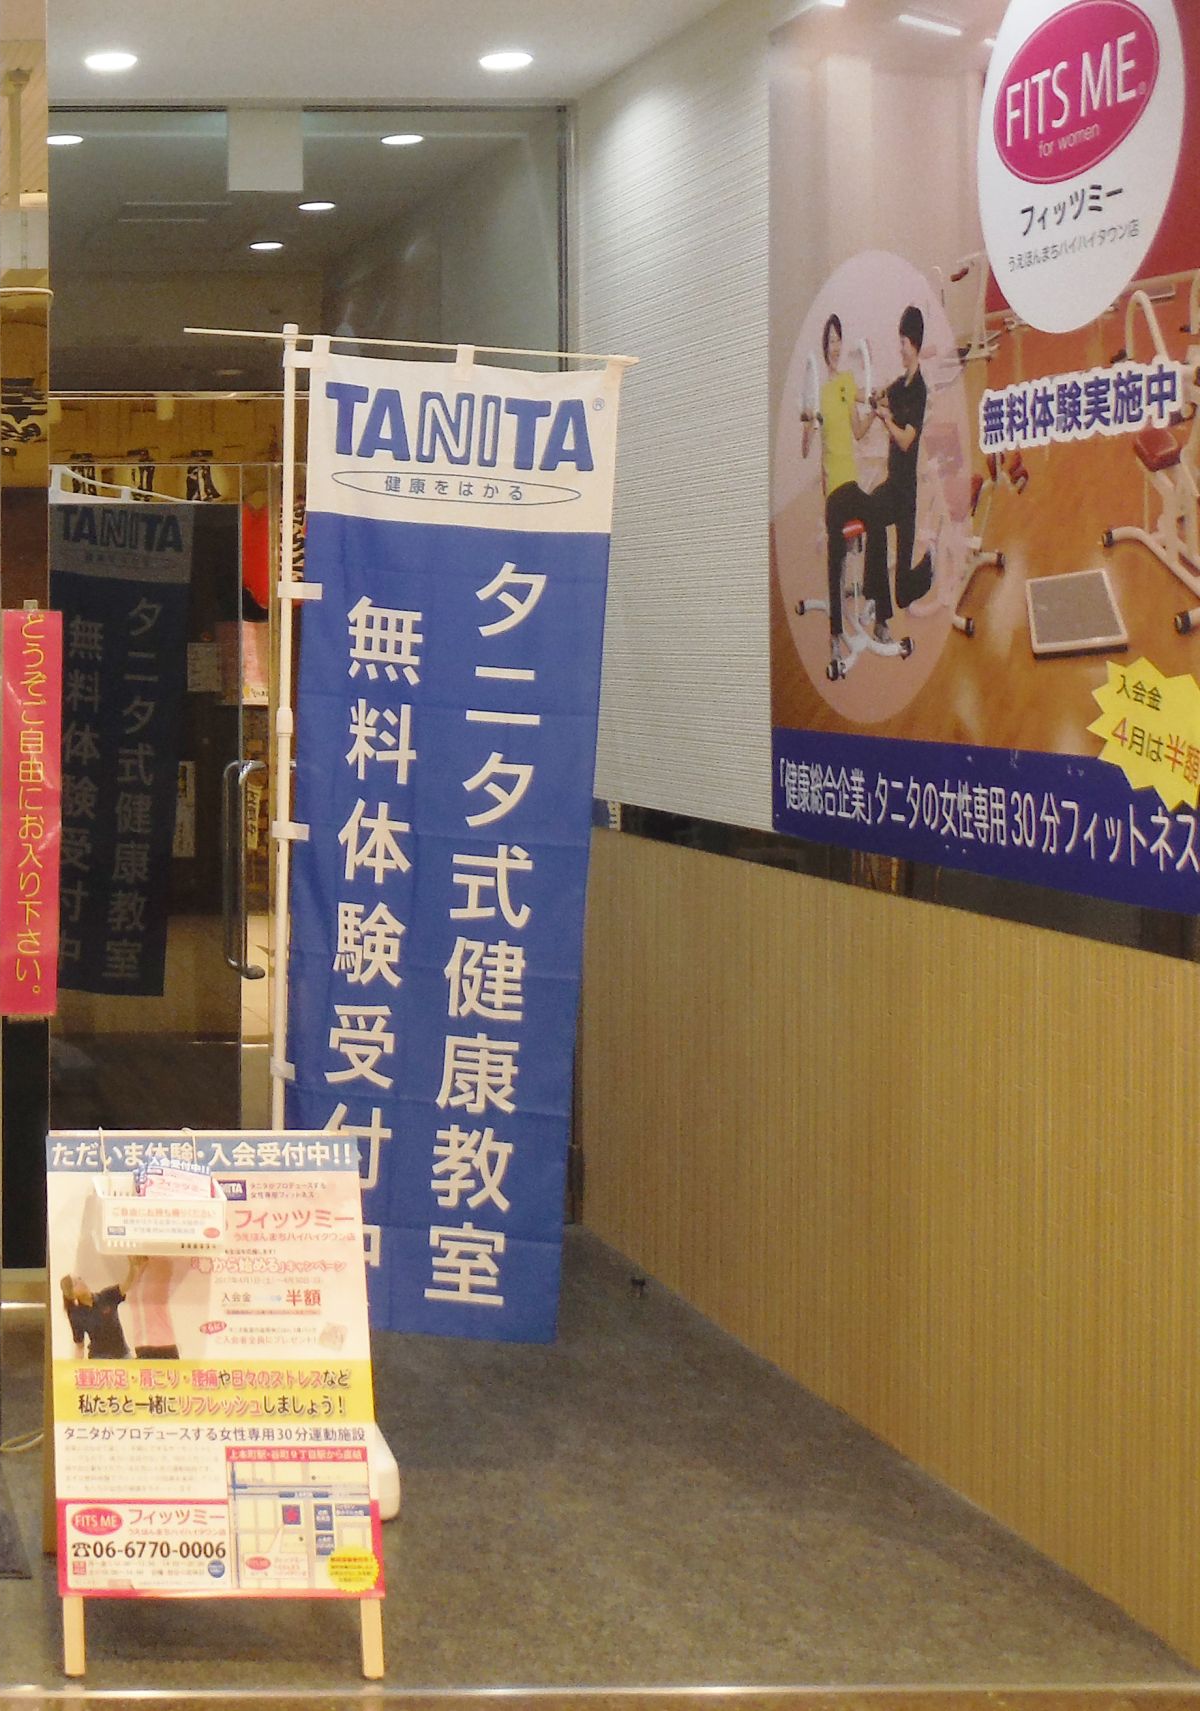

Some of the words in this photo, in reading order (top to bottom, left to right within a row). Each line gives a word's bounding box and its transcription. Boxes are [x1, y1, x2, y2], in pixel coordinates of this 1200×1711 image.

[1006, 61, 1069, 147] FITS
[1080, 32, 1136, 117] ME
[1039, 141, 1054, 158] for
[1058, 123, 1099, 149] women
[1020, 184, 1123, 236] フィッツミー
[983, 364, 1178, 445] 無料体験実施中
[325, 381, 595, 472] TANITA
[384, 474, 523, 501] 健康をはかる
[1116, 674, 1162, 711] 入会金
[16, 614, 47, 994] どうぞご自由にお入り下さい。
[424, 561, 547, 1306] タニタ式健康教室
[234, 1209, 355, 1229] フィッツミー
[286, 1289, 321, 1306] 半額
[75, 1514, 97, 1527] FITS
[101, 1514, 118, 1527] ME
[128, 1508, 225, 1525] フィッツミー
[93, 1541, 226, 1559] 06-6770-0006
